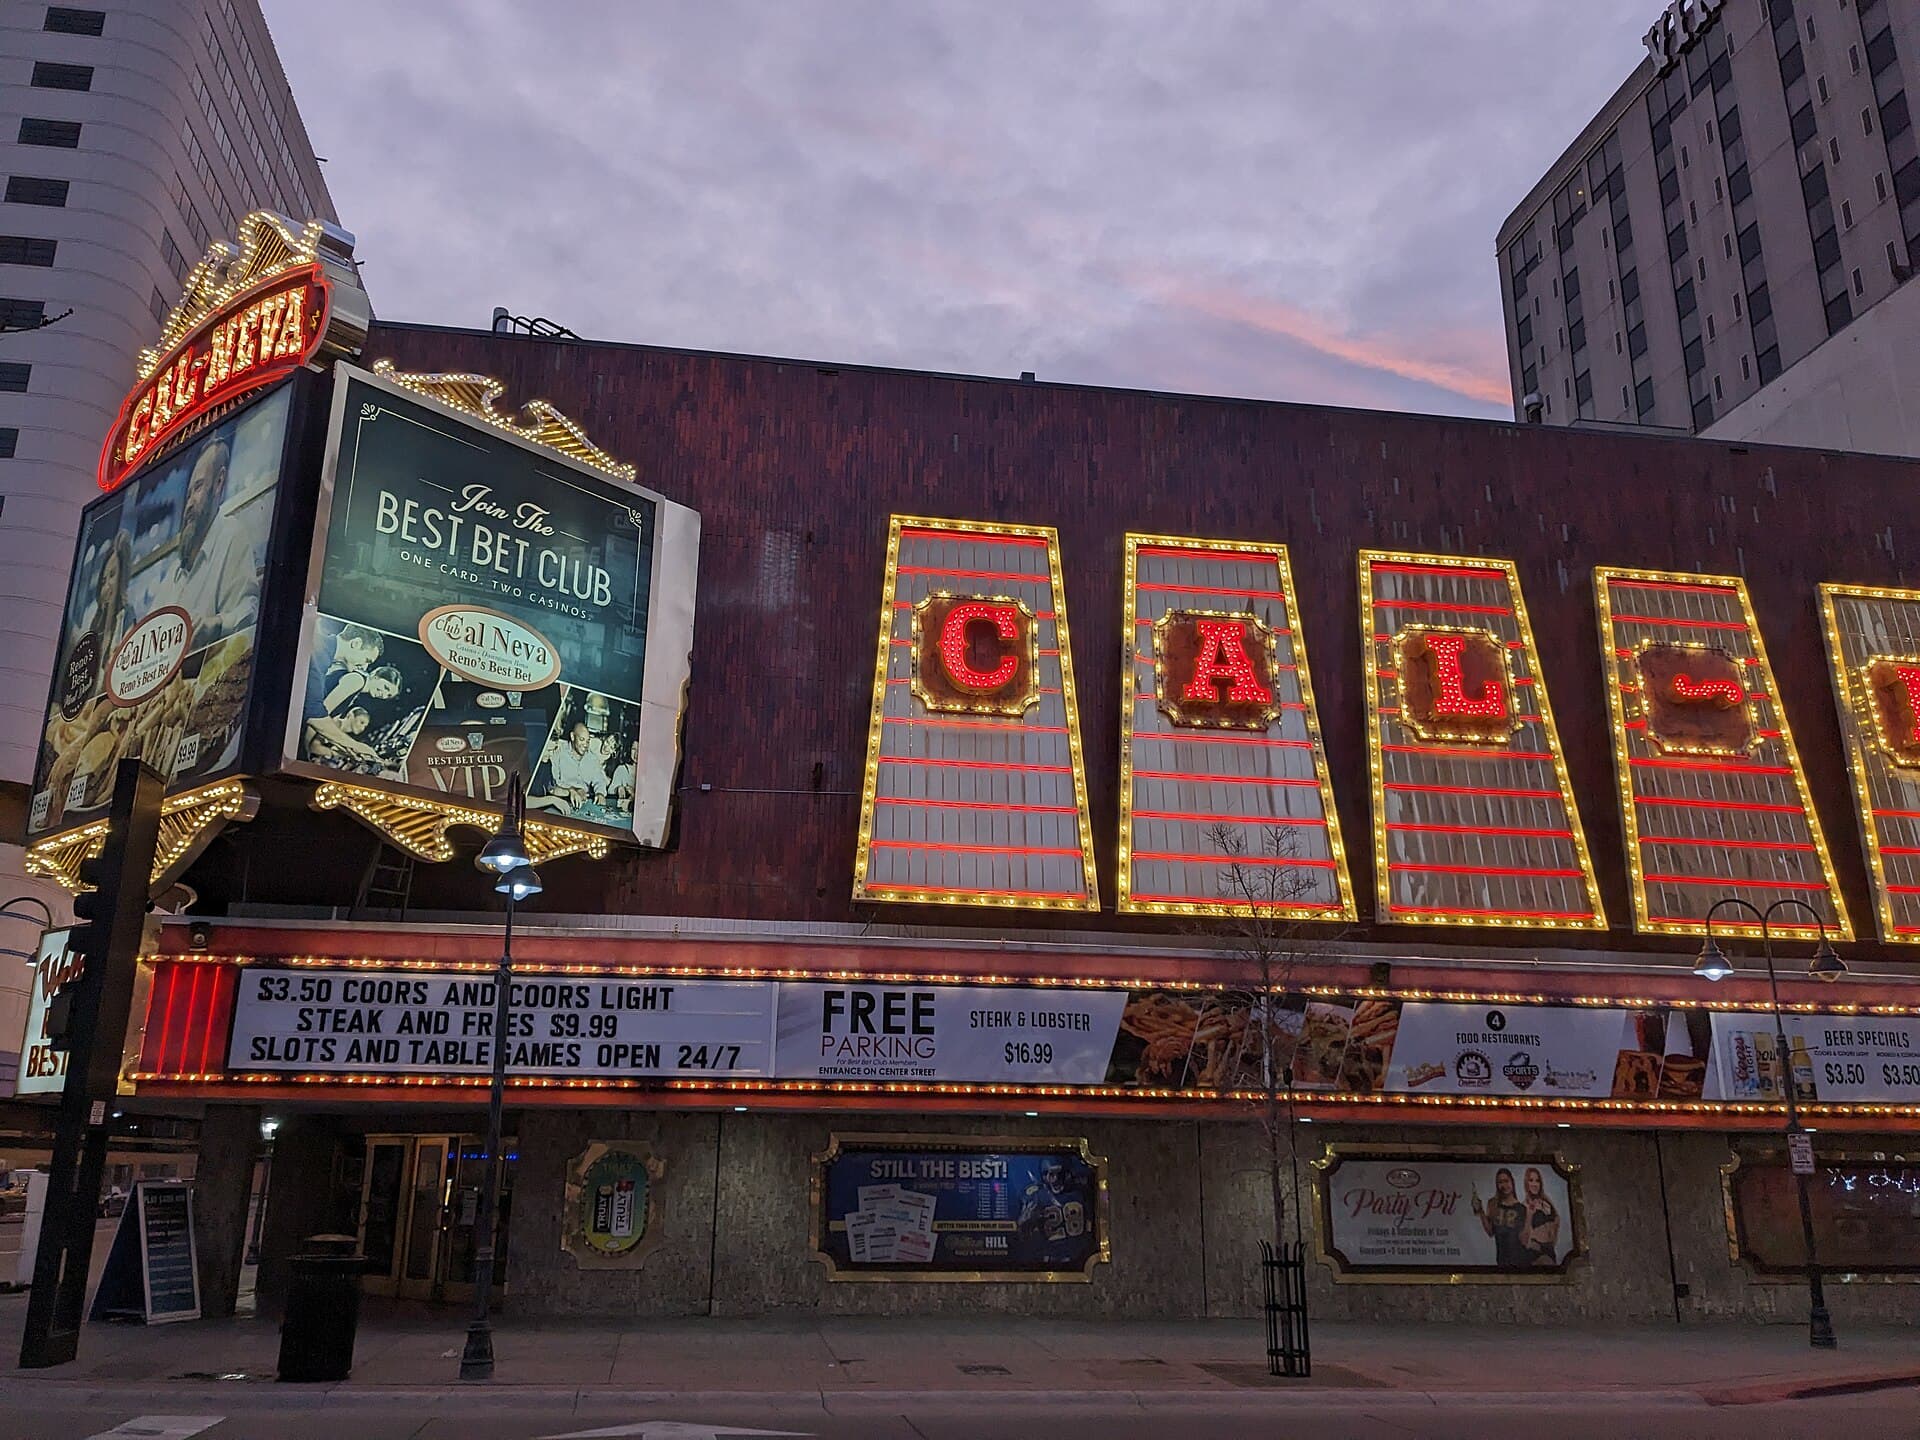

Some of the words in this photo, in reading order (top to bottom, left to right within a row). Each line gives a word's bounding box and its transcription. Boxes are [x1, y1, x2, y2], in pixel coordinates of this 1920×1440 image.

[125, 285, 309, 466] CAL-NEVA
[451, 483, 509, 519] Join
[512, 502, 555, 537] The
[376, 490, 463, 556] BEST
[471, 524, 530, 578] BET
[537, 550, 612, 607] CLUB
[401, 551, 431, 568] ONE
[440, 564, 483, 585] CARD.
[492, 580, 521, 597] TWO
[529, 593, 592, 621] CASINOS.
[435, 619, 460, 635] Club
[446, 615, 484, 648] Cal
[121, 634, 145, 671] Cal
[145, 623, 183, 660] Neva
[491, 626, 547, 664] Neva
[69, 648, 94, 677] Reno's
[448, 649, 486, 671] Reno's
[489, 662, 511, 677] Best
[515, 669, 532, 682] Bet
[71, 668, 88, 689] Best
[119, 675, 142, 697] Reno's
[142, 668, 157, 686] Best
[157, 661, 170, 678] Bet
[177, 739, 197, 764] $9.99
[428, 756, 452, 766] BEST
[455, 755, 474, 764] BET
[477, 754, 504, 764] CLUB
[429, 764, 507, 801] VIP
[257, 977, 332, 1002] $3.50
[343, 980, 428, 1004] COORS
[443, 982, 496, 1006] AND
[509, 984, 591, 1009] COORS
[601, 986, 674, 1011] LIGHT
[297, 1007, 384, 1033] STEAK
[396, 1010, 450, 1035] AND
[462, 1012, 535, 1037] FRES
[550, 1013, 618, 1038] $9.99
[822, 991, 936, 1034] FREE
[970, 1010, 1012, 1030] STEAK
[1018, 1012, 1026, 1027] &
[1031, 1013, 1091, 1032] LOBSTER
[1492, 1014, 1500, 1027] 4
[250, 1036, 337, 1062] SLOTS
[344, 1039, 400, 1063] AND
[408, 1040, 490, 1065] TABLE
[597, 1044, 661, 1068] OPEN
[678, 1045, 741, 1070] 24/7
[821, 1036, 936, 1059] PARKING
[1004, 1042, 1053, 1065] $16.99
[1456, 1032, 1479, 1045] FOOD
[1482, 1032, 1541, 1047] RESTAURANTS
[1824, 1030, 1853, 1047] BEER
[1858, 1031, 1910, 1048] SPECIALS
[819, 1067, 861, 1075] ENTRANCE
[863, 1067, 877, 1075] ON
[879, 1067, 909, 1076] CENTER
[910, 1068, 936, 1076] STREET
[1504, 1067, 1538, 1075] SPORTS
[1825, 1063, 1865, 1085] $3.50
[871, 1160, 916, 1178] STILL
[919, 1161, 955, 1178] THE
[958, 1160, 1008, 1178] BEST!
[597, 1196, 607, 1230] TRULY
[616, 1192, 626, 1231] TRULY
[1343, 1188, 1415, 1227] Party
[1416, 1190, 1462, 1218] Pit
[984, 1236, 1008, 1248] HILL
